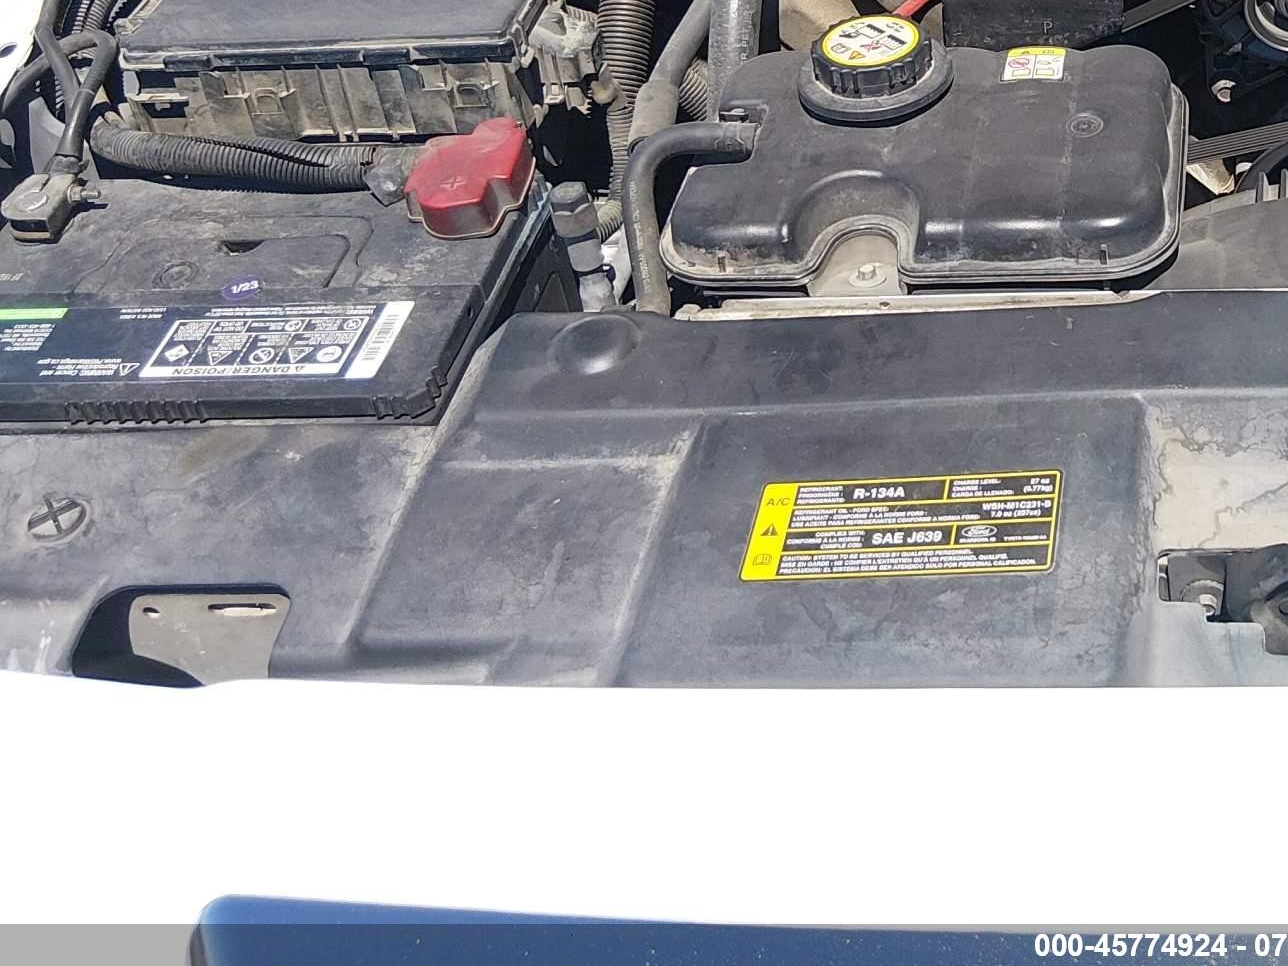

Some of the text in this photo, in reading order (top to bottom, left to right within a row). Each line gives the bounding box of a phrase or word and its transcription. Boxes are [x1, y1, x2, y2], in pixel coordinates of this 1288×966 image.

[231, 280, 259, 295] 1/23
[171, 366, 289, 375] DANGER/POISON
[853, 486, 905, 499] R-134A
[766, 497, 790, 506] A/C
[871, 531, 943, 545] SAE J639
